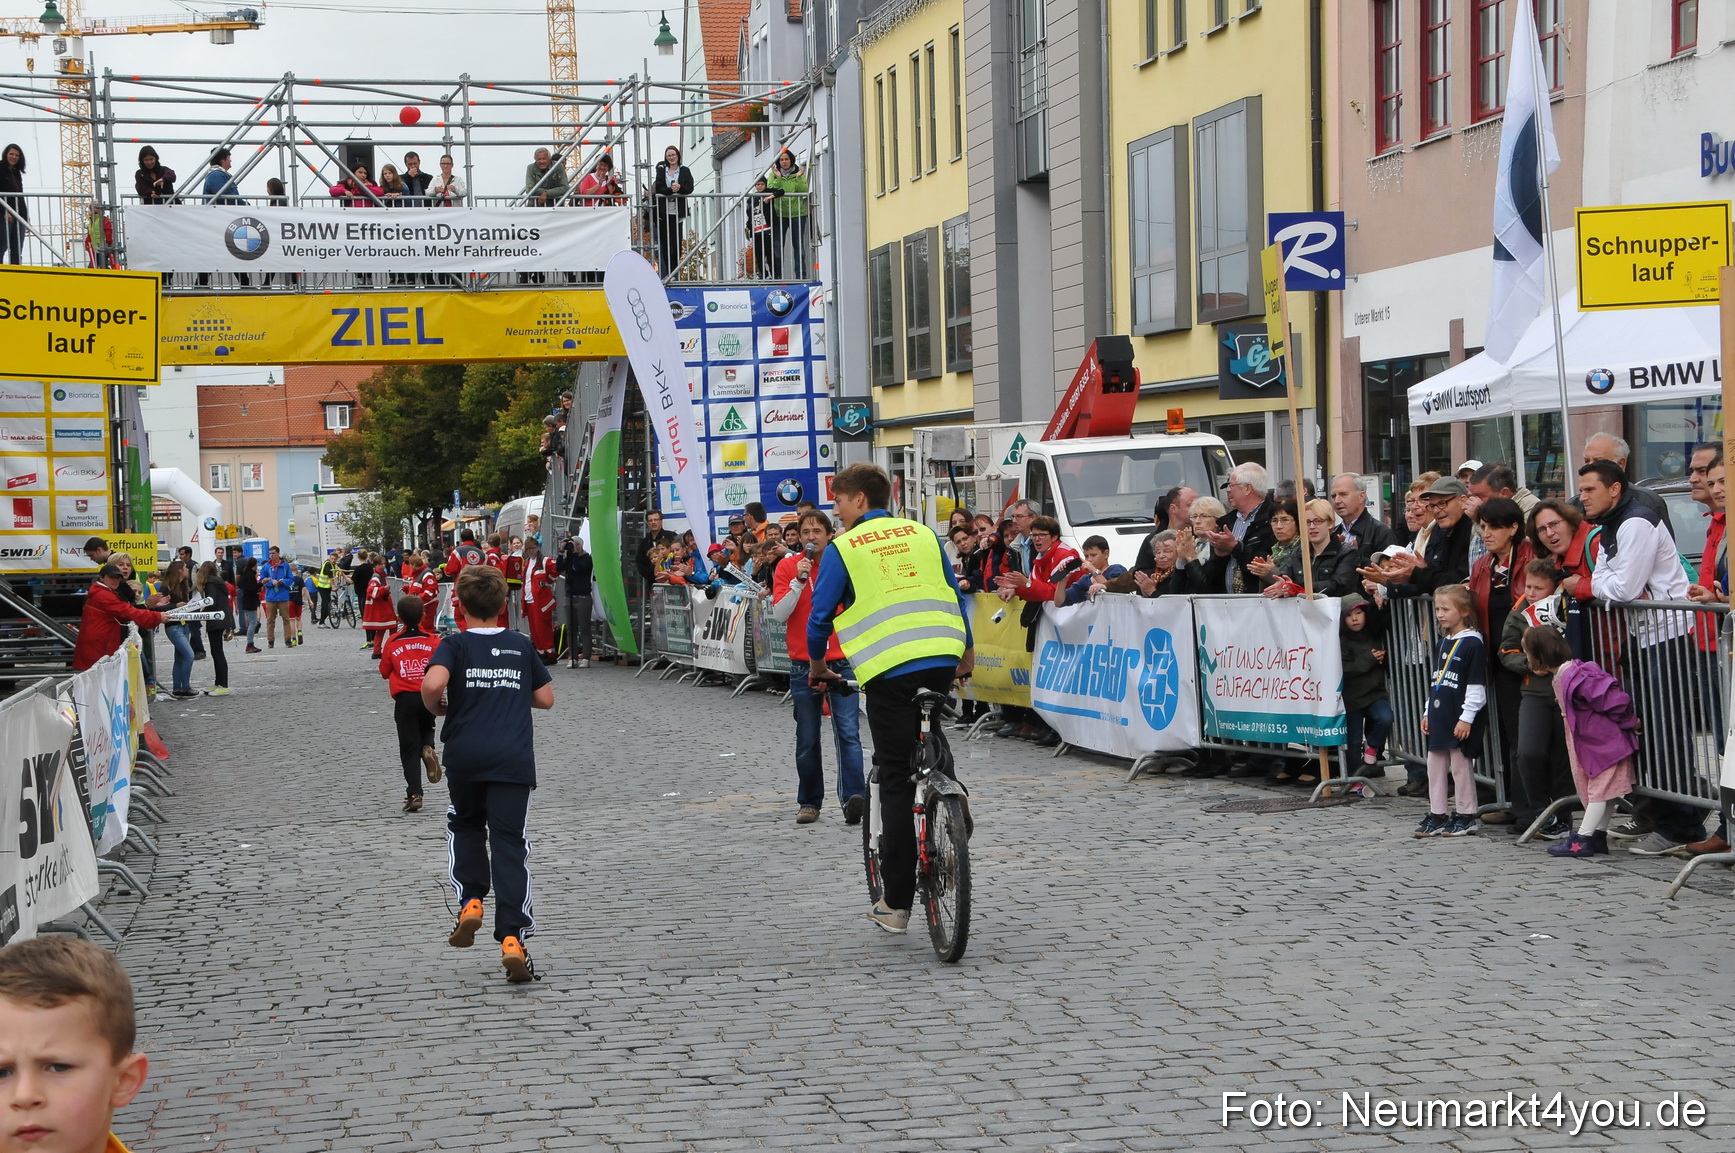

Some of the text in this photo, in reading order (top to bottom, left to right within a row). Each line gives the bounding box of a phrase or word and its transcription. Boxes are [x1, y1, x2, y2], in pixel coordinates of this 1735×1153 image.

[228, 218, 266, 233] BMW
[281, 222, 541, 245] BMW EfficientDynamics
[282, 244, 543, 260] Weniger Verbrauch. Mehr Fahrfreude.
[1586, 236, 1719, 258] Schnupper-
[1632, 260, 1674, 282] lauf
[0, 298, 147, 329] Schnupper-
[1354, 305, 1391, 326] Unterer Markt 15
[331, 307, 444, 346] ZIEL
[505, 325, 611, 336] Neumarkter Stadtlauf
[47, 331, 95, 354] lauf
[161, 330, 266, 342] eumarkter Stadtlauf
[773, 343, 788, 351] Braun
[1247, 344, 1270, 374] G2
[763, 376, 801, 384] HACKNER
[1629, 359, 1721, 390] BMW L
[1432, 384, 1491, 411] BMW Laufsport
[764, 409, 805, 424] Charivari
[844, 409, 860, 427] G2
[14, 514, 32, 523] Braun
[848, 525, 918, 549] HELFER
[0, 548, 34, 557] swn
[104, 540, 153, 551] Treffpunkt
[870, 542, 908, 555] NEUMARKTER
[880, 547, 910, 558] STADTLAUF
[392, 646, 404, 657] TSV
[1236, 646, 1265, 670] UNS
[465, 668, 522, 681] GRUNDSCHULE
[476, 680, 491, 688] Haus
[1276, 724, 1288, 734] 52
